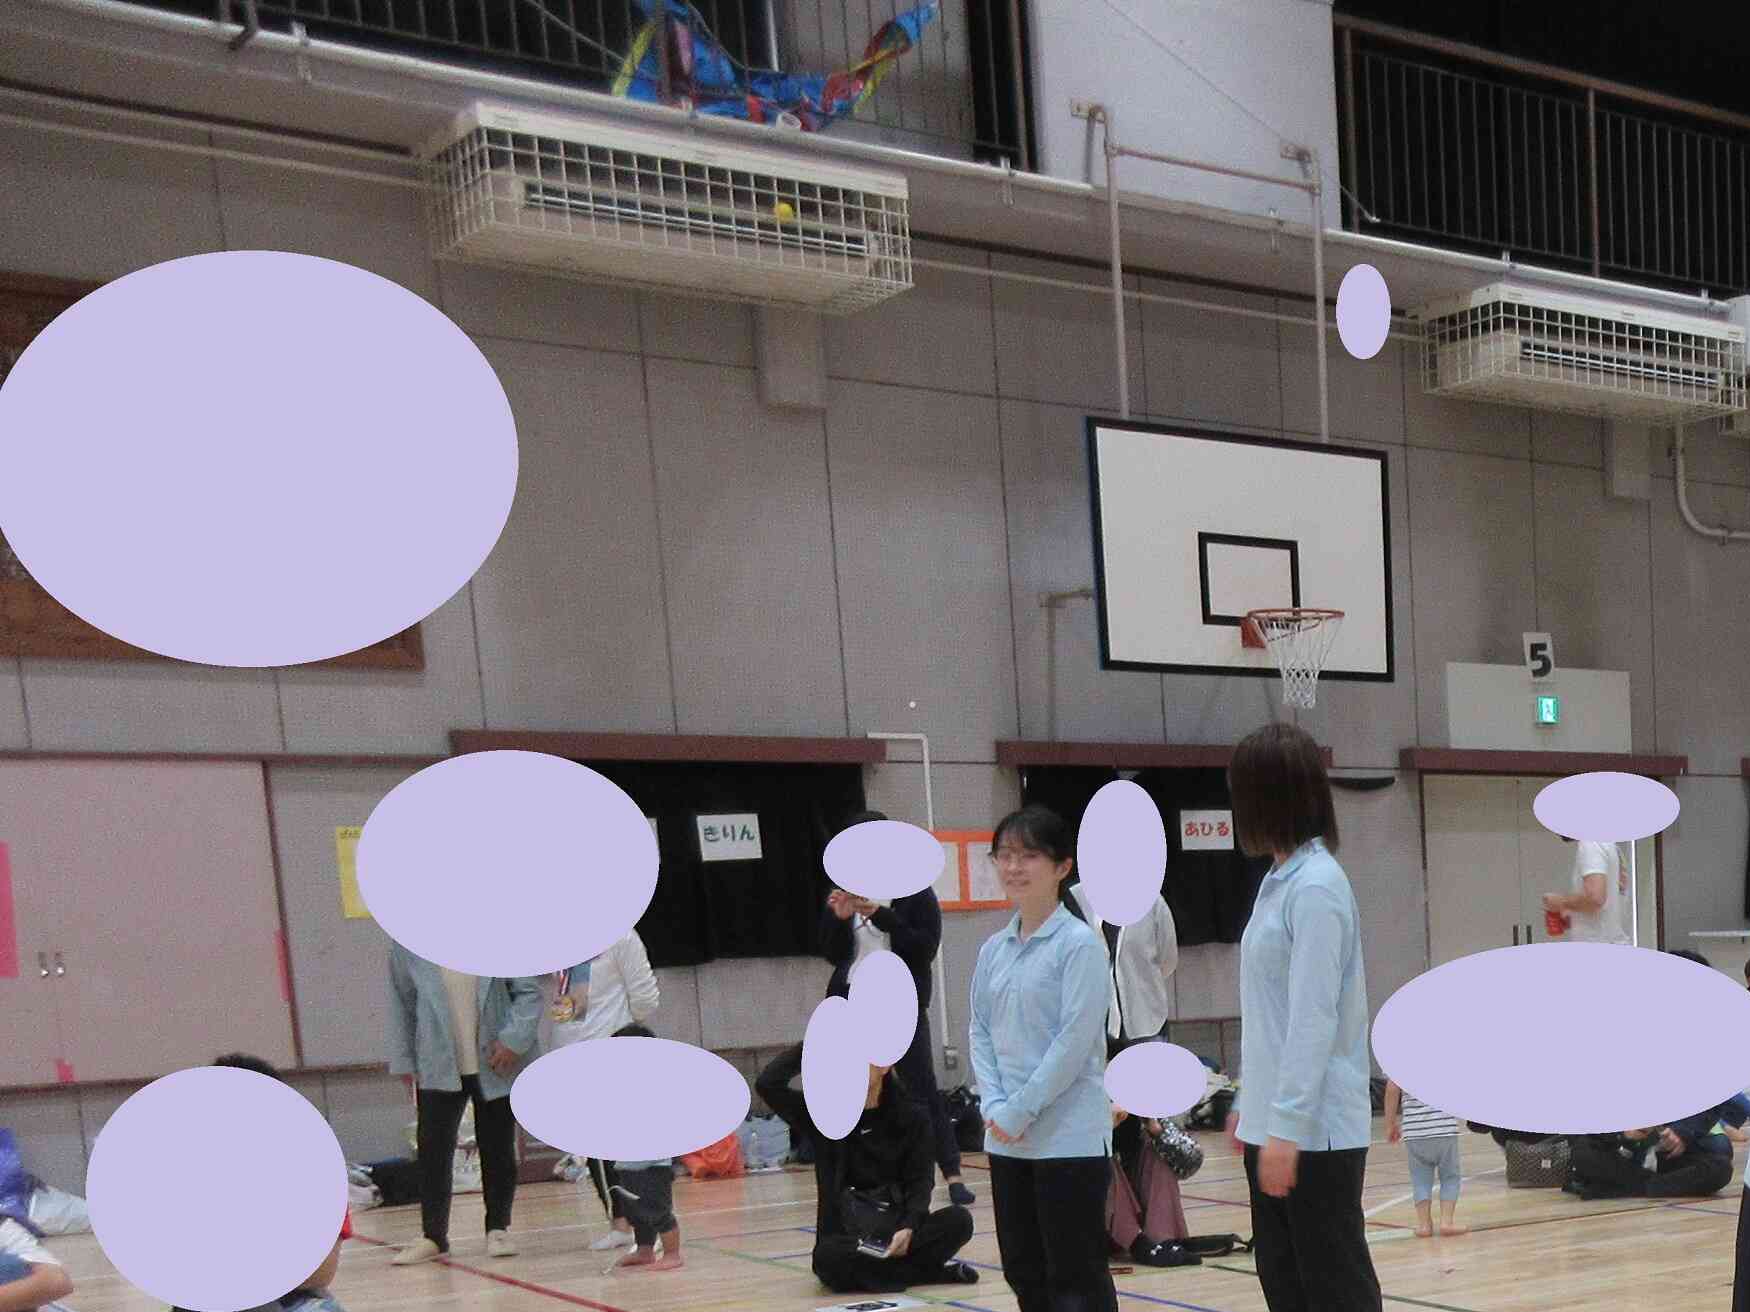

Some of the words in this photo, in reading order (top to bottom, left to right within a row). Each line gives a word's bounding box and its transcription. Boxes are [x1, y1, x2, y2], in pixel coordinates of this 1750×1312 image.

[1530, 642, 1553, 678] 5
[704, 824, 755, 842] きりん
[1184, 820, 1230, 837] あひる
